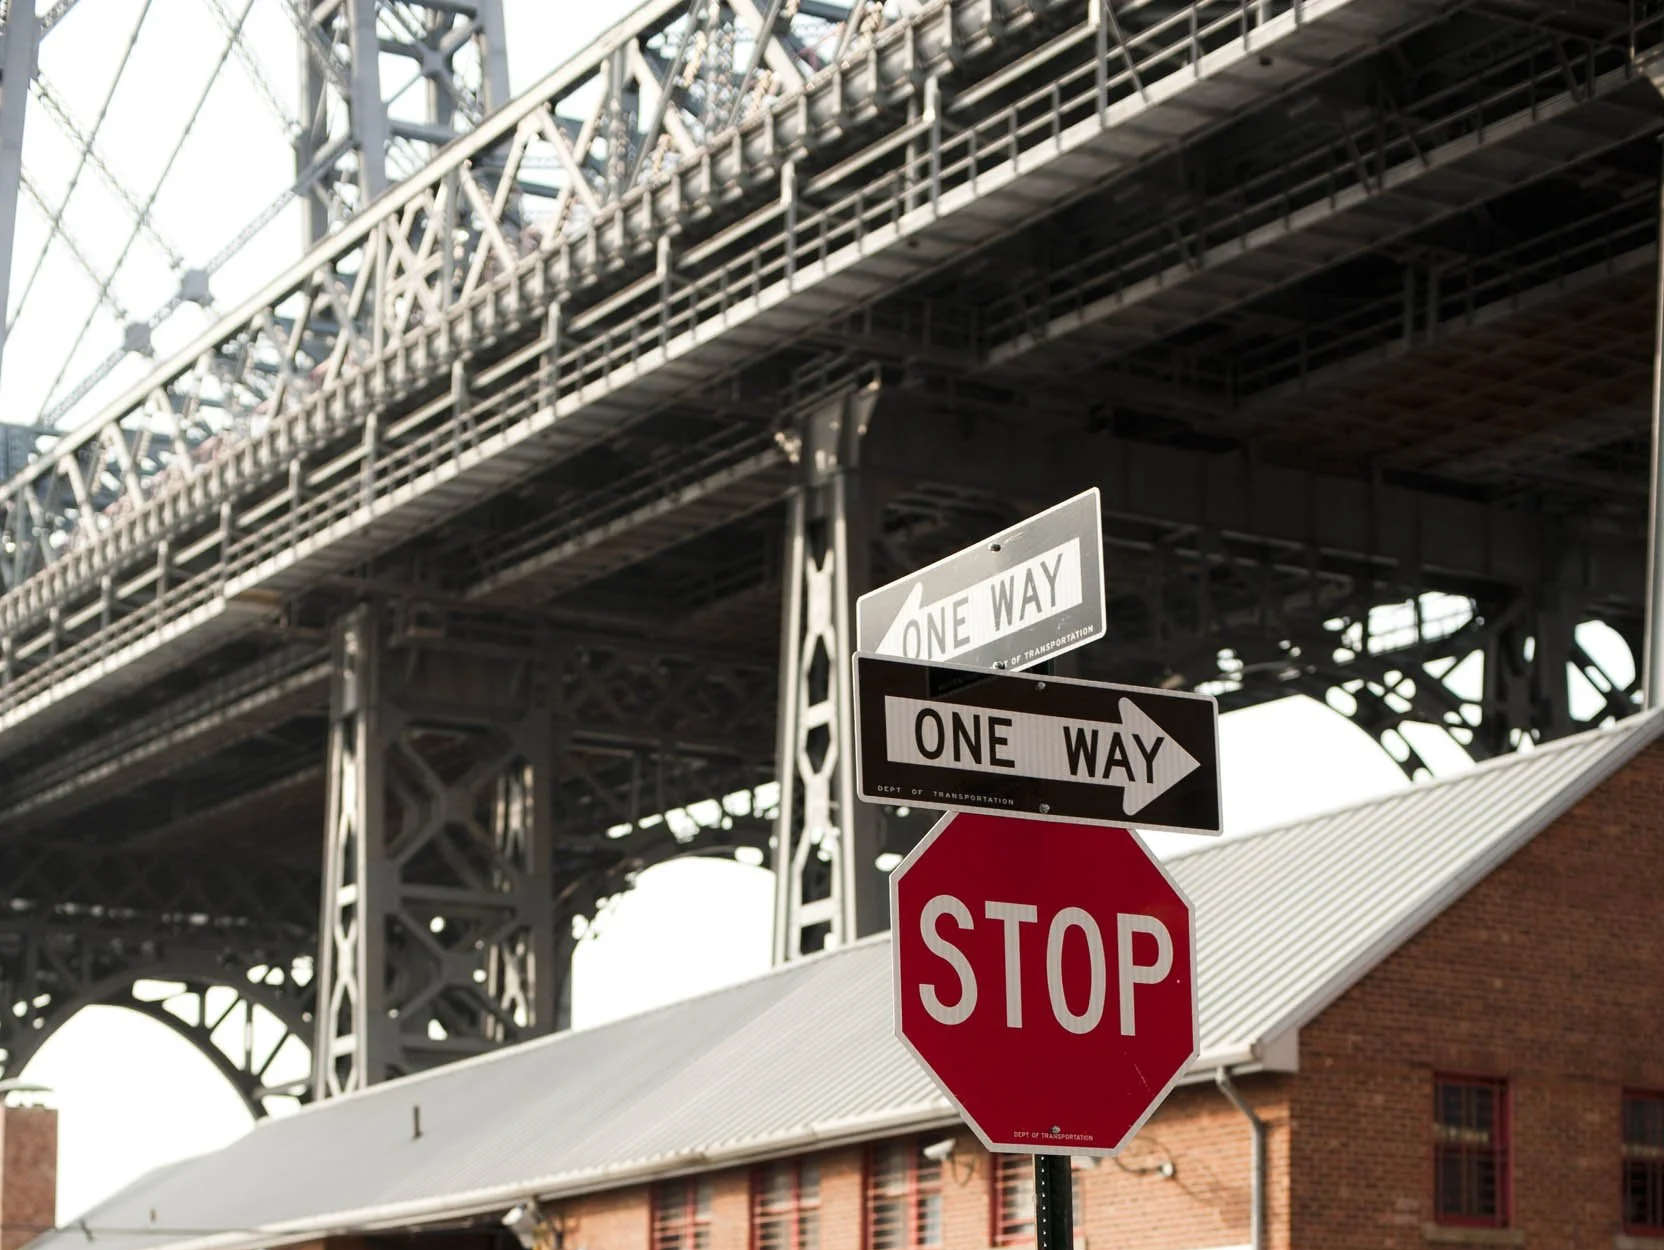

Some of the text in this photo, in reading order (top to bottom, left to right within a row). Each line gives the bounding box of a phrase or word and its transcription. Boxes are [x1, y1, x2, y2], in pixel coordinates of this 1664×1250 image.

[902, 553, 1063, 661] ONE WAY
[1011, 655, 1021, 665] OF
[1024, 625, 1094, 659] TRANSPORTATION
[915, 708, 1164, 784] ONE WAY
[878, 785, 901, 793] DEPT
[934, 791, 1014, 805] TRANSPORTATION
[919, 894, 1174, 1037] STOP
[1041, 1132, 1093, 1141] TRANSPORTATION
